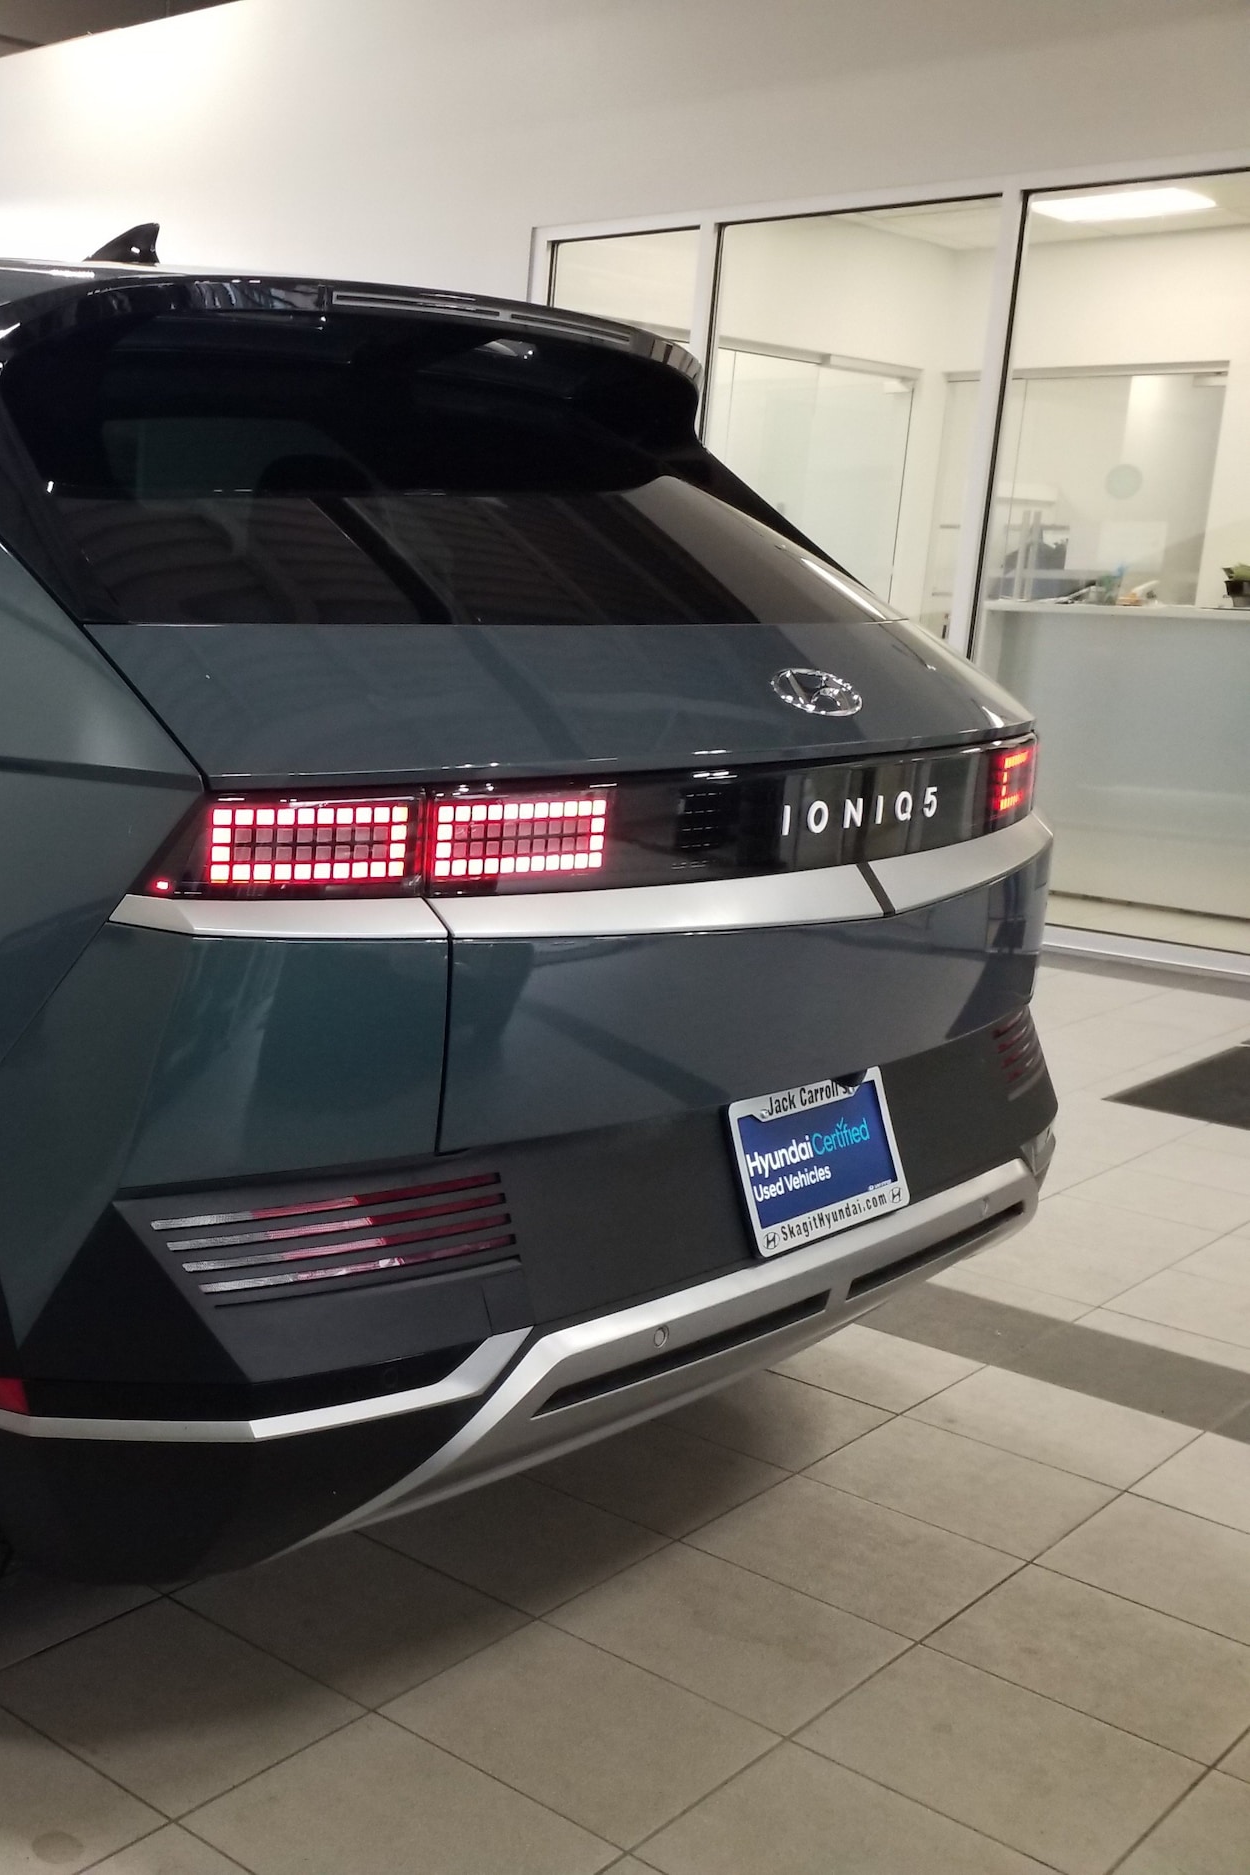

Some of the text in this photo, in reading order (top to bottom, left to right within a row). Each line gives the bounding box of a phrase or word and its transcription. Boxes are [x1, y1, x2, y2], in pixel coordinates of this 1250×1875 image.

[767, 1080, 848, 1116] Jack Carrolls
[753, 1165, 832, 1202] Used Vehicles
[781, 1195, 887, 1242] SkagitHyundai.com
